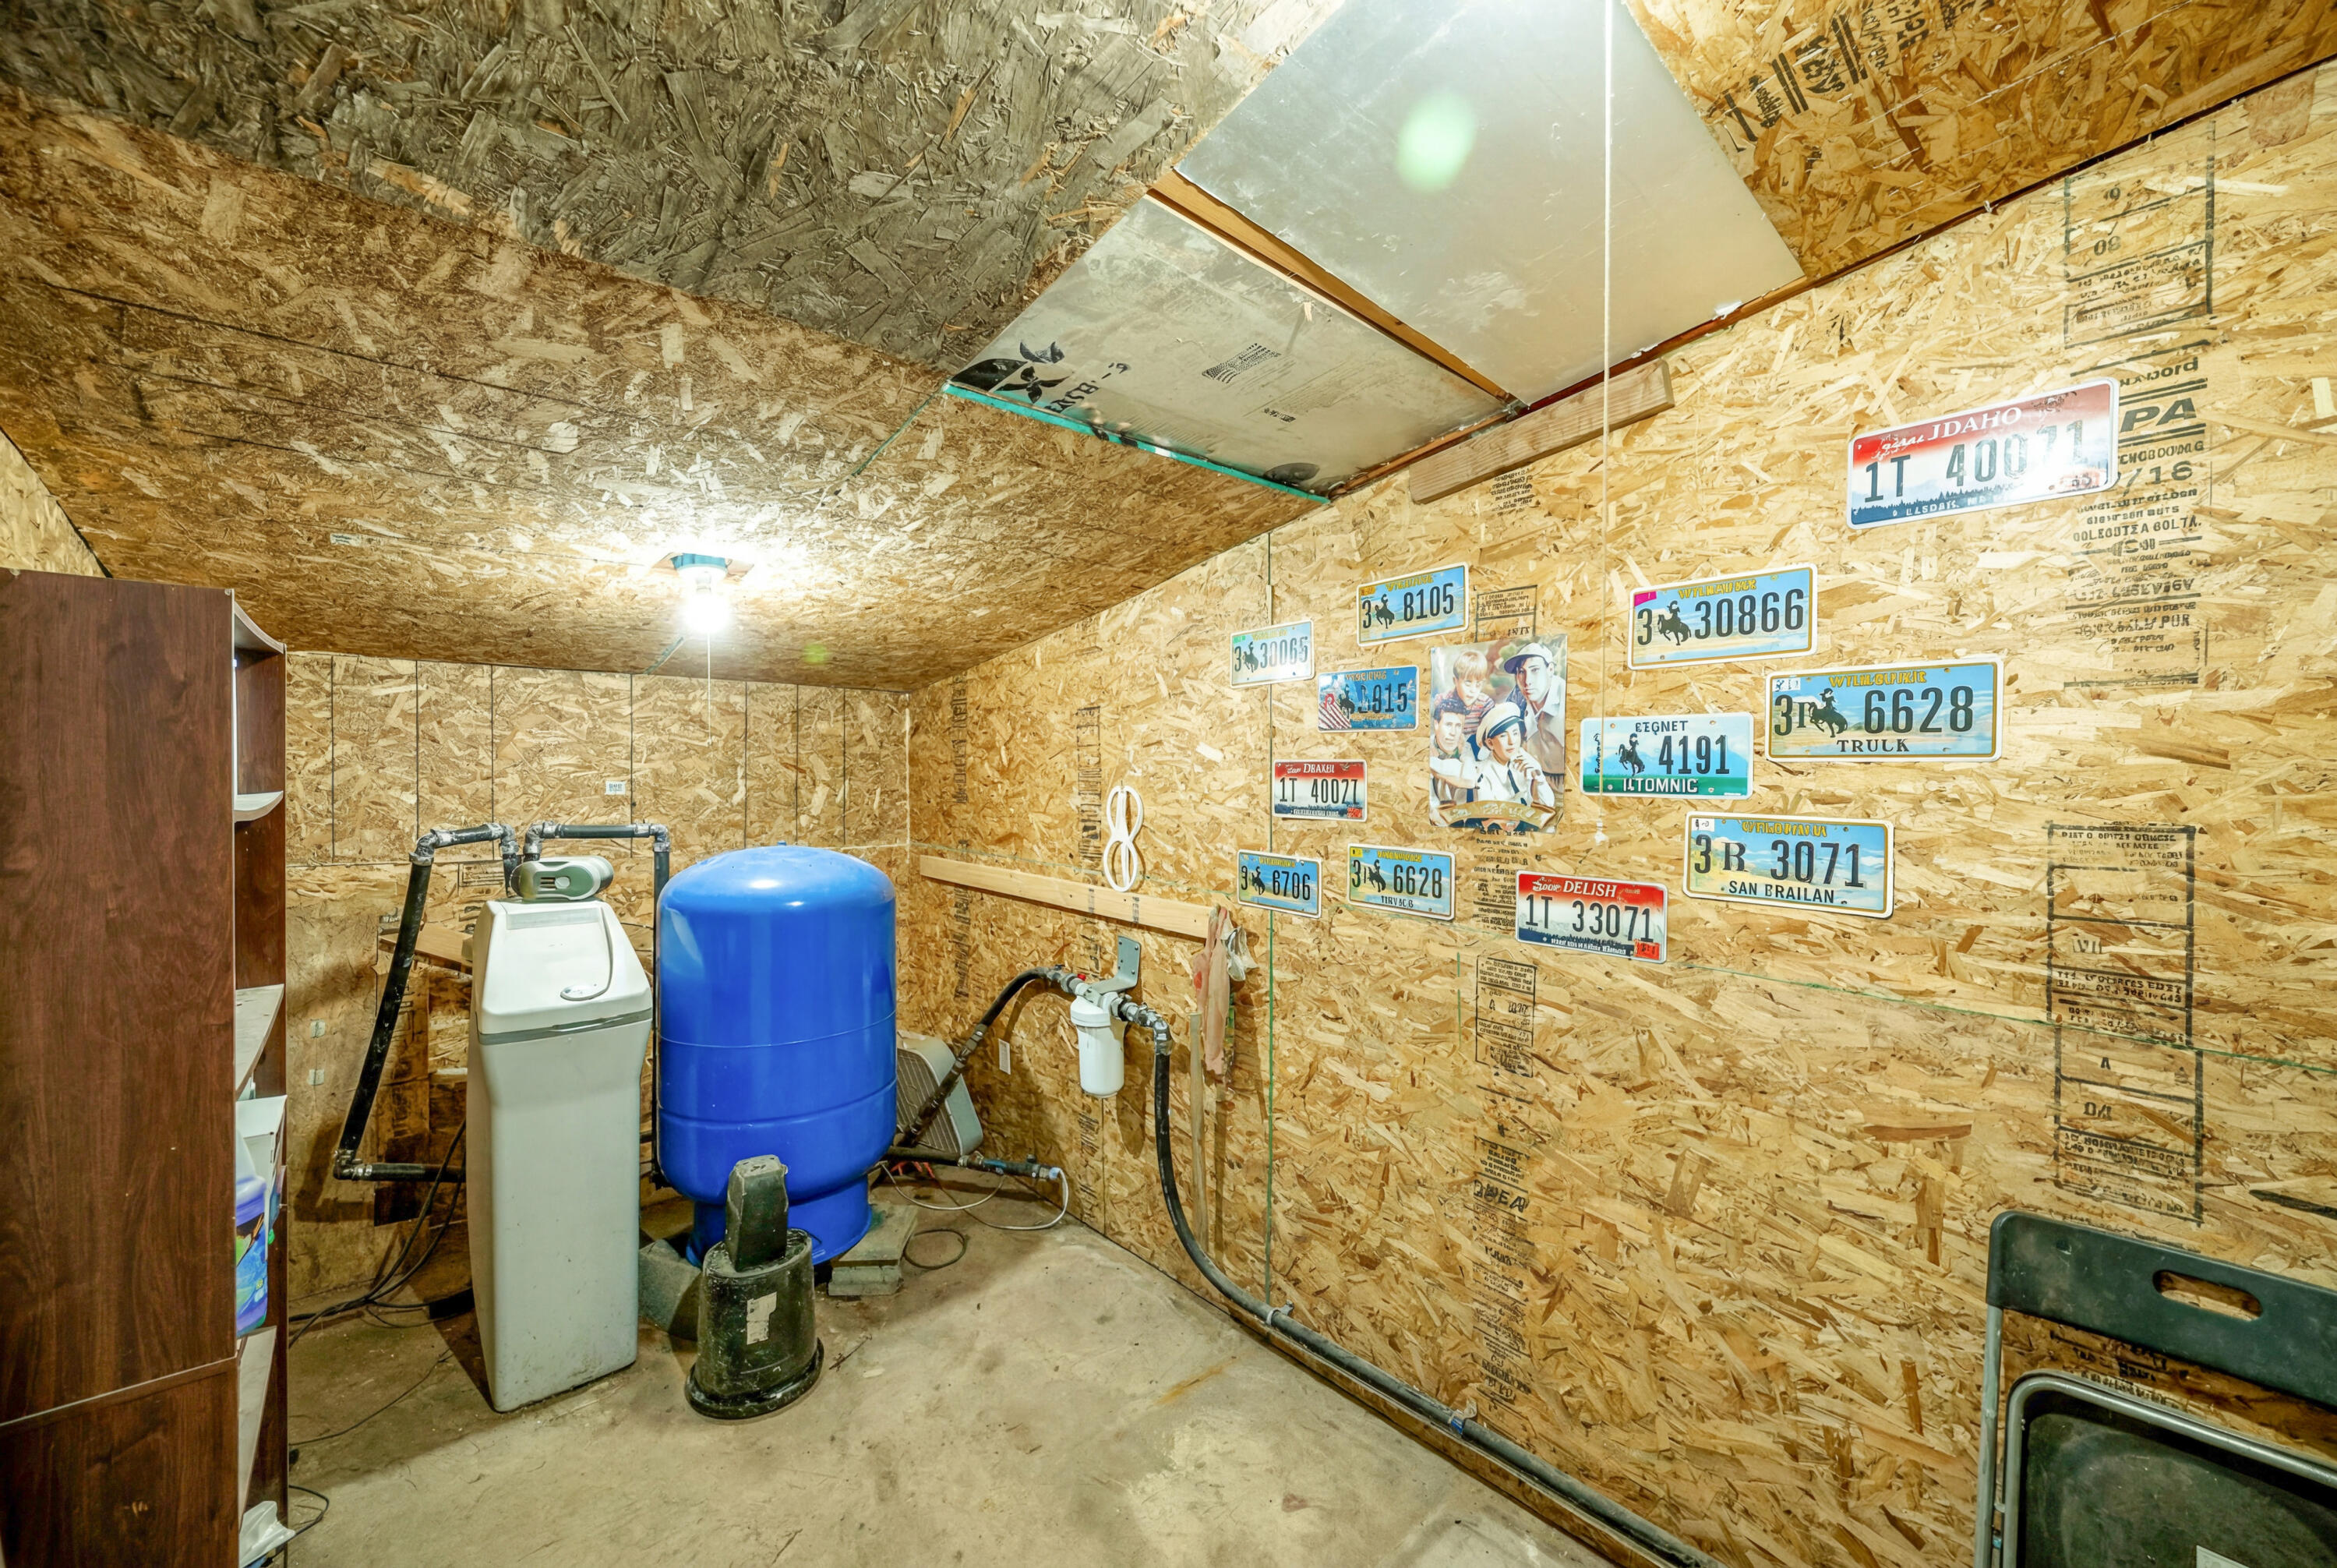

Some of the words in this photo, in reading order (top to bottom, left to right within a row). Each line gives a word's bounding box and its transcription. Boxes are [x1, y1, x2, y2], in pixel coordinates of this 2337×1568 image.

[1925, 406, 2023, 441] IDAHO
[1361, 599, 1371, 629] 3
[1403, 582, 1454, 622] 8105
[1637, 608, 1653, 646] 3
[1694, 588, 1805, 640] 30866
[1864, 685, 1974, 734] 6628
[1658, 734, 1730, 775] 4191
[1393, 863, 1442, 899] 6628
[1770, 839, 1864, 888] 3071
[1728, 880, 1758, 896] SAN
[1572, 899, 1654, 943] 33071
